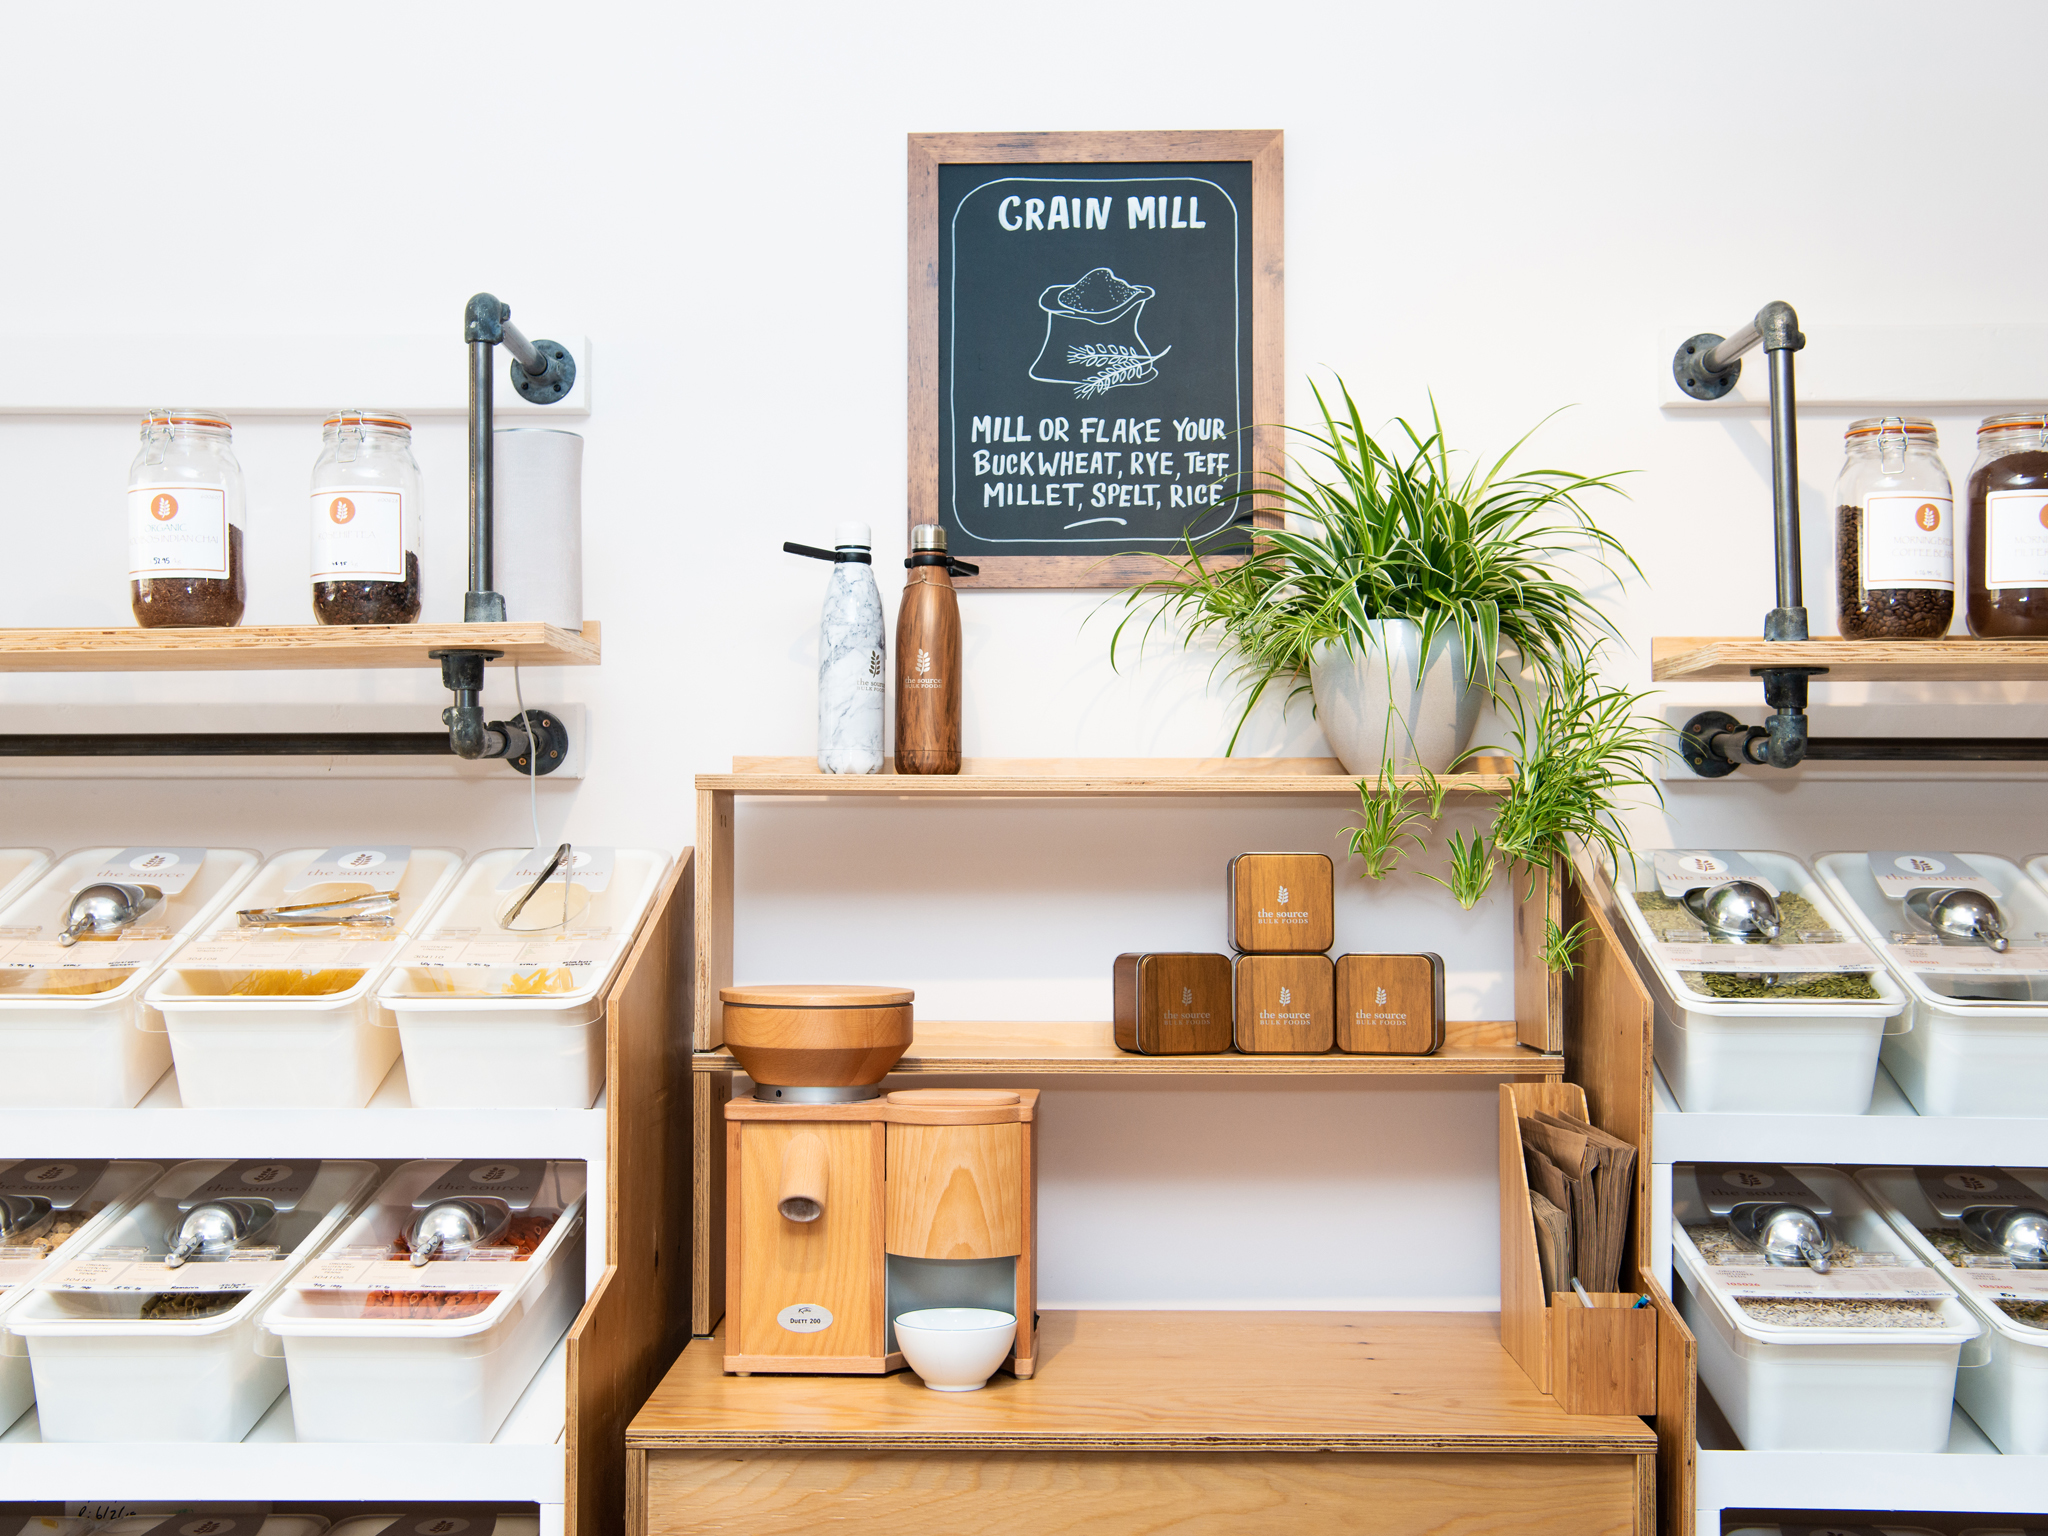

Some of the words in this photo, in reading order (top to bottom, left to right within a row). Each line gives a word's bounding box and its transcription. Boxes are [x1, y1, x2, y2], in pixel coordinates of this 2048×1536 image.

[998, 195, 1113, 232] GRAIN
[1127, 196, 1207, 230] MILL
[971, 415, 1032, 444] MILL
[1038, 416, 1070, 443] OR
[1079, 417, 1162, 445] FLAKE
[1172, 416, 1228, 443] YOUR
[973, 449, 1123, 480] BUCKWHEAT,
[1130, 451, 1181, 481] RYE,
[1183, 451, 1230, 483] TEFF,
[983, 482, 1085, 512] MILLET,
[1090, 482, 1162, 511] SPELT,
[1170, 483, 1226, 508] RICE
[856, 677, 870, 687] the
[905, 676, 916, 684] the
[97, 869, 123, 878] the
[307, 869, 334, 877] the
[515, 869, 539, 878] the
[1667, 873, 1694, 882] the
[1886, 873, 1913, 882] the
[1258, 908, 1273, 918] the
[1276, 910, 1308, 918] source
[1163, 1010, 1179, 1019] the
[1181, 1011, 1211, 1019] source
[1259, 1010, 1275, 1019] the
[1278, 1012, 1311, 1020] source
[1355, 1010, 1371, 1019] the
[1373, 1012, 1407, 1020] source
[206, 1183, 235, 1193] the
[436, 1182, 465, 1192] the
[469, 1184, 529, 1192] source
[1710, 1188, 1742, 1197] the
[1745, 1189, 1807, 1198] source
[1937, 1191, 1967, 1200] the
[809, 1317, 822, 1325] 200
